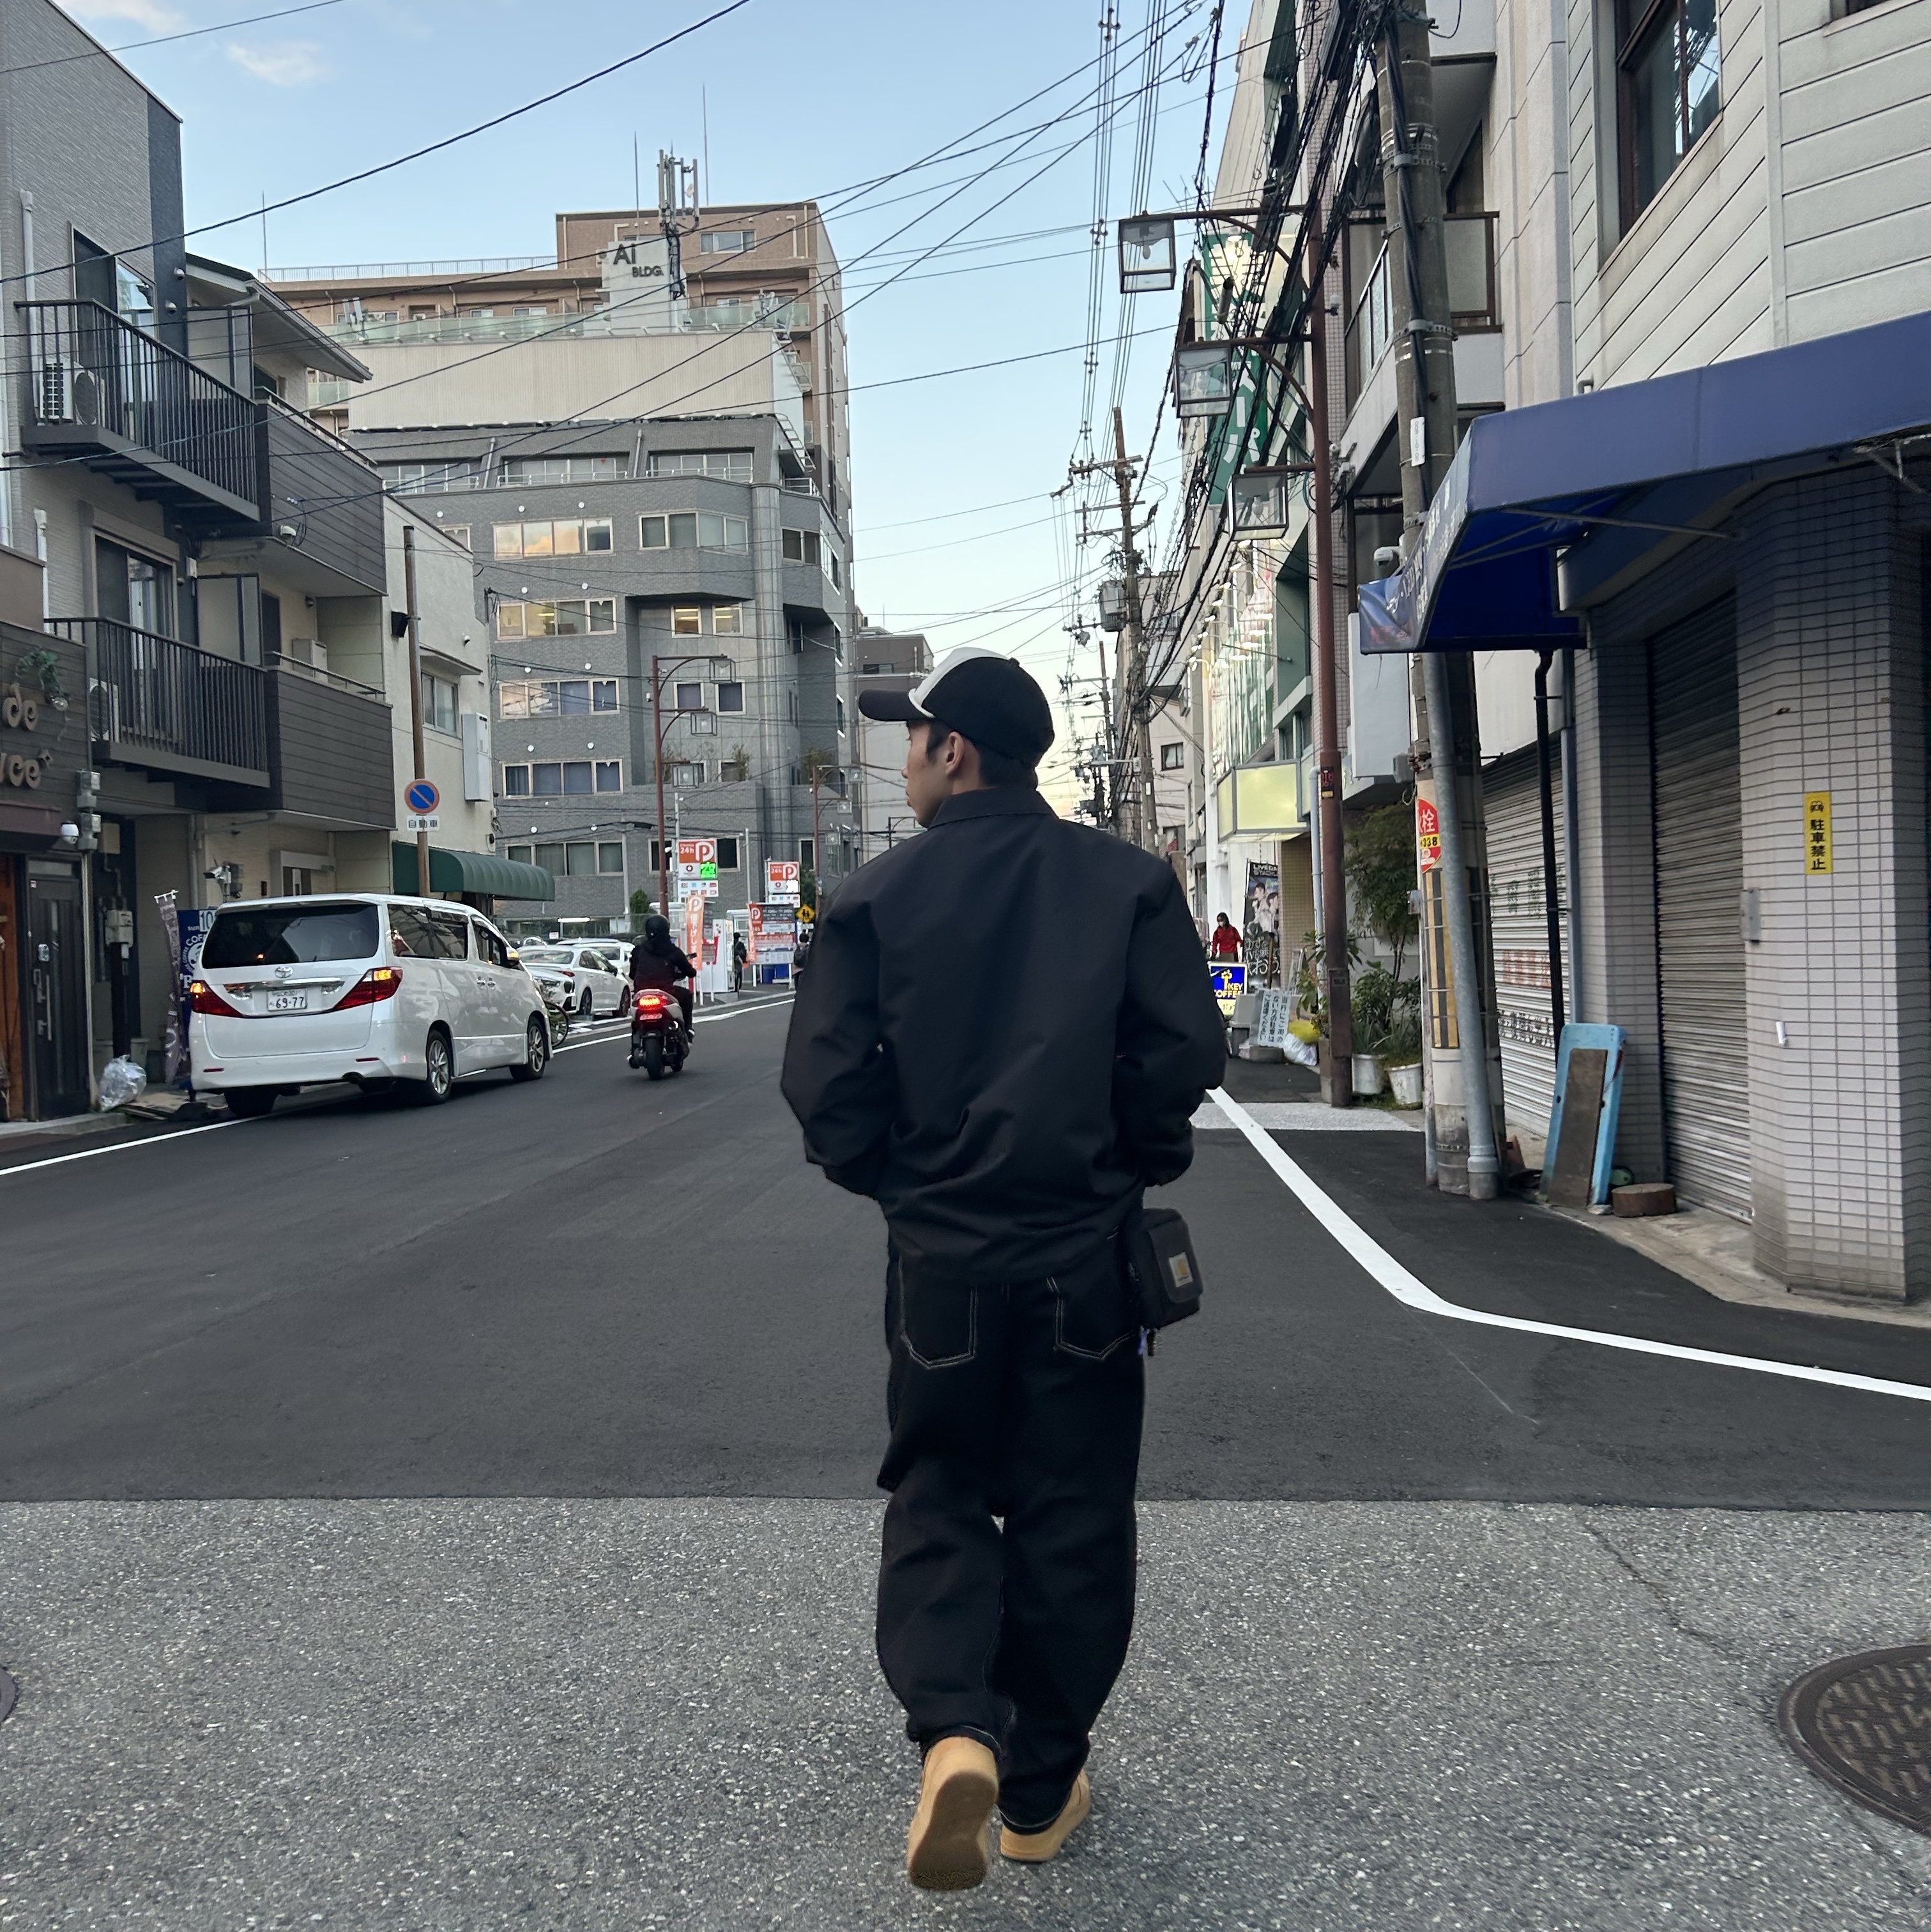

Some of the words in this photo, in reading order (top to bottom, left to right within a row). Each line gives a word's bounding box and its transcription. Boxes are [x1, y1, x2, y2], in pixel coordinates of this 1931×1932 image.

[632, 266, 665, 277] BLDG.
[3, 683, 38, 731] de
[408, 819, 438, 828] 自動車
[695, 842, 714, 862] P
[1810, 819, 1826, 870] 駐車禁止
[783, 864, 797, 879] P
[689, 896, 703, 911] P
[751, 908, 761, 920] P
[276, 997, 304, 1008] 69-77
